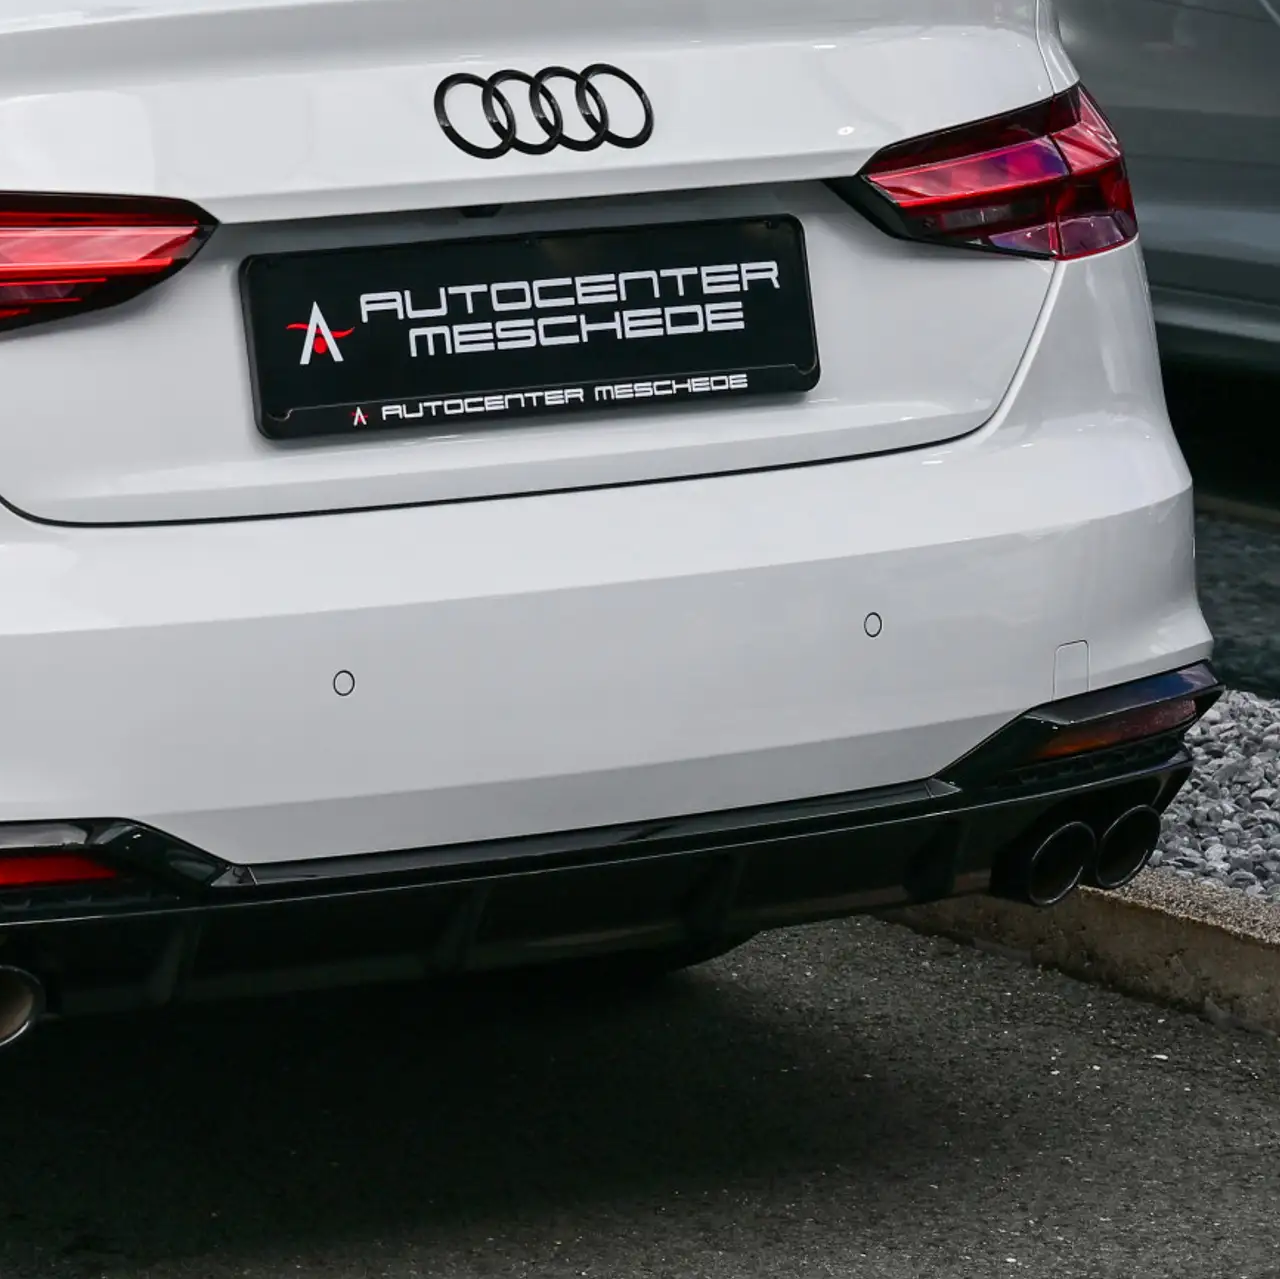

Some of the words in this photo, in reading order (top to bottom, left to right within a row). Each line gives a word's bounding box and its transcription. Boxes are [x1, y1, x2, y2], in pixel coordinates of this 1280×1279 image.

[359, 260, 781, 323] AUTOCENTER
[408, 301, 746, 358] MESCHEDE
[381, 387, 585, 420] AUTOCENTER
[594, 374, 748, 402] MESCHEDE
